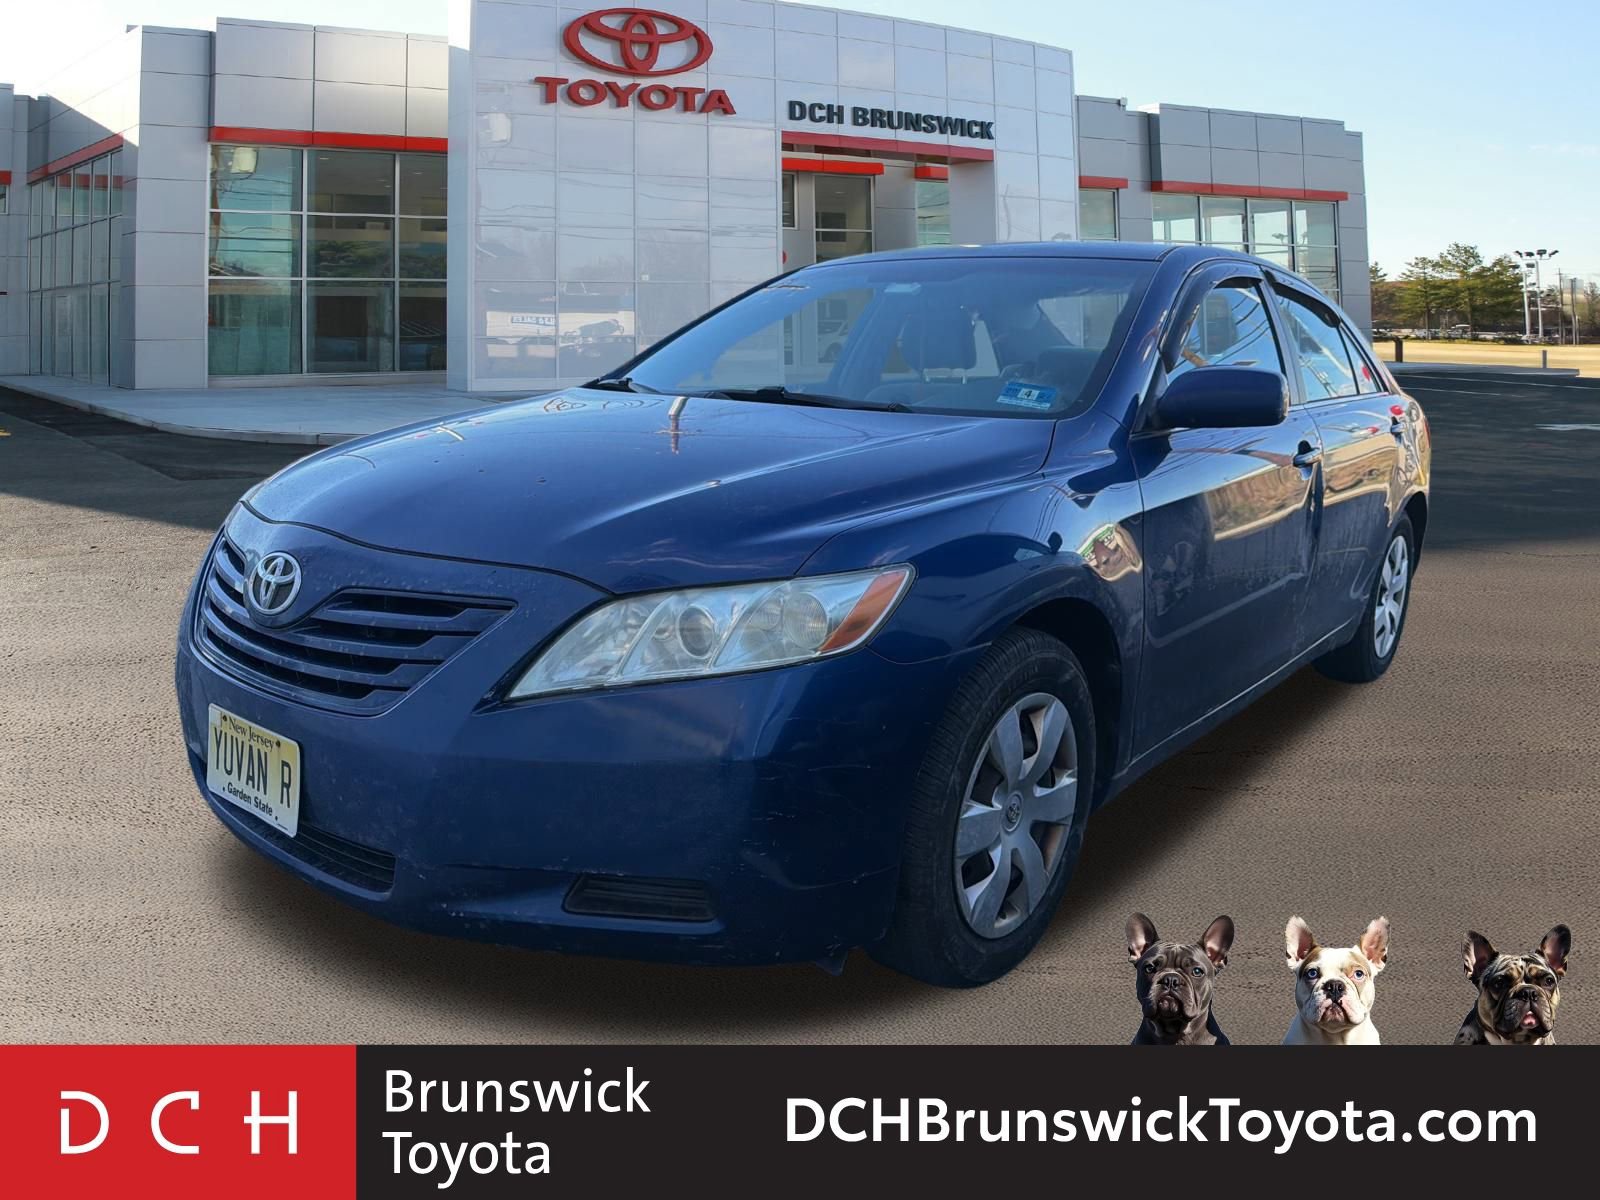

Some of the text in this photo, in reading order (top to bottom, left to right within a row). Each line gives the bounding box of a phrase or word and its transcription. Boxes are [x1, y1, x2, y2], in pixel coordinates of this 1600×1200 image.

[534, 76, 736, 115] TOYOTA
[788, 99, 995, 140] DCH BRUNSWICK
[229, 717, 275, 752] New Jersey
[214, 727, 292, 808] YUVAN R
[227, 783, 274, 815] Garden State
